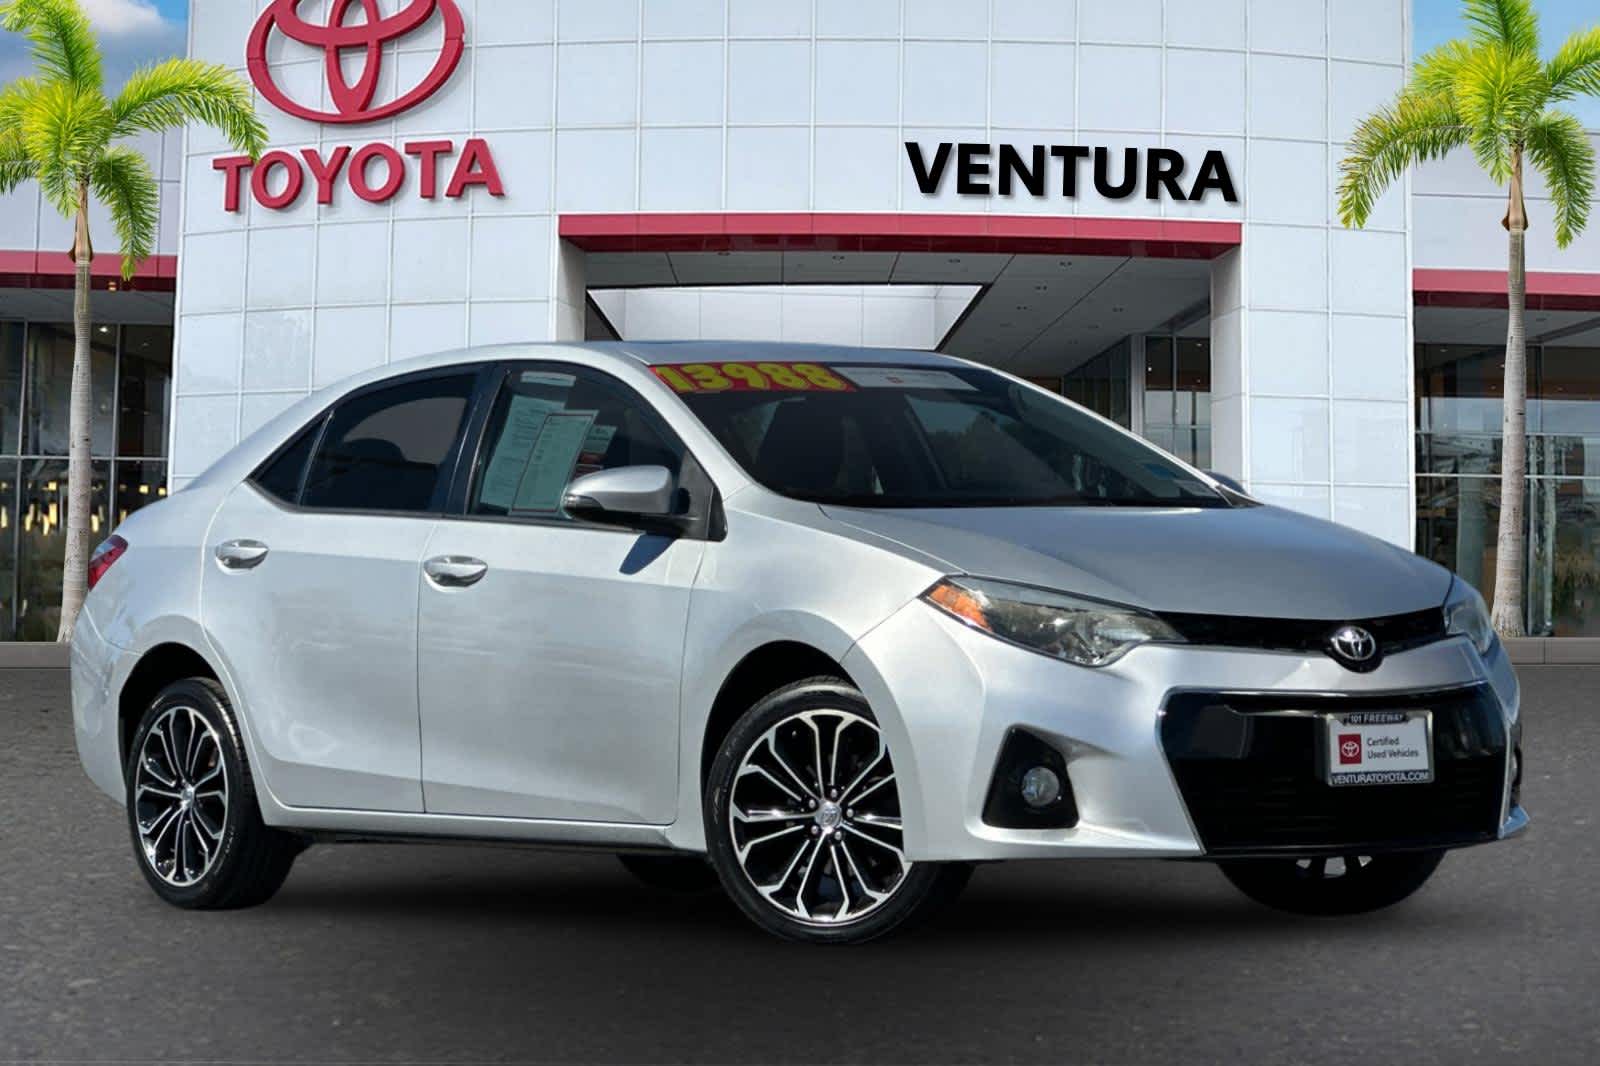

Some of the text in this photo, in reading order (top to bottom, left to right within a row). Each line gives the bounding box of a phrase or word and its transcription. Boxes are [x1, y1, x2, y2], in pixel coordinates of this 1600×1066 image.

[212, 138, 505, 212] TOYOTA
[904, 142, 1238, 203] VENTURA
[654, 363, 848, 391] 13988
[1367, 736, 1400, 746] Certified
[1367, 750, 1387, 759] Used
[1332, 771, 1429, 784] VENTURATOYOTA.COM
